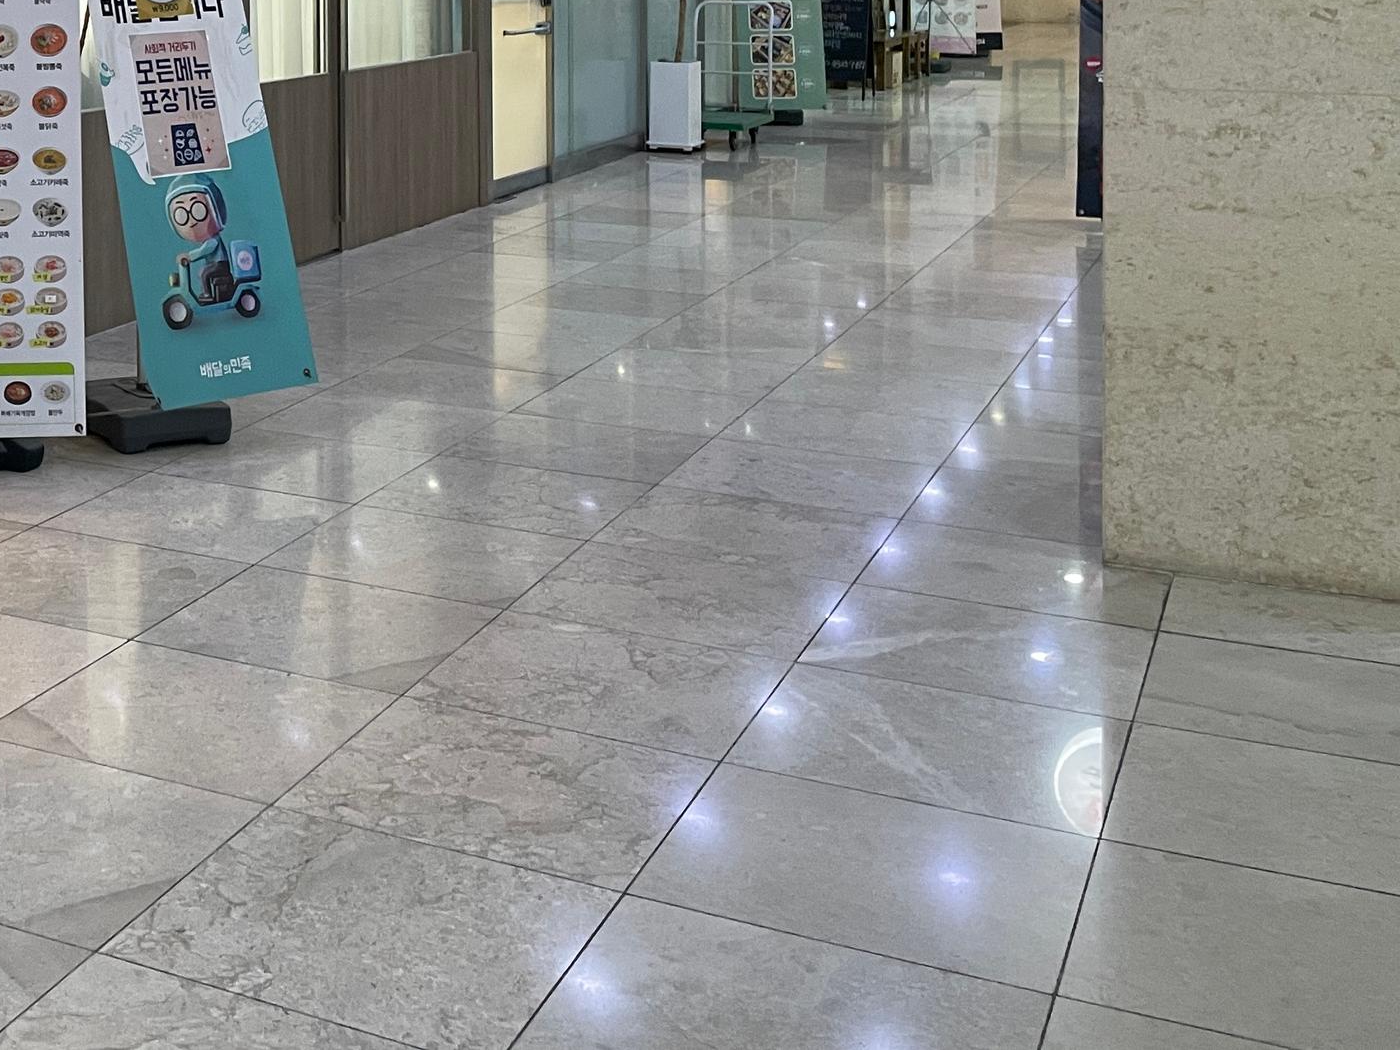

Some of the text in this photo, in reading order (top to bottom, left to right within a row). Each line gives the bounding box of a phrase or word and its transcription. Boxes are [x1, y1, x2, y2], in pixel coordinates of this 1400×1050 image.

[135, 56, 212, 85] 모든메뉴
[140, 86, 217, 115] 포장가능
[199, 355, 252, 378] 배달의민족
